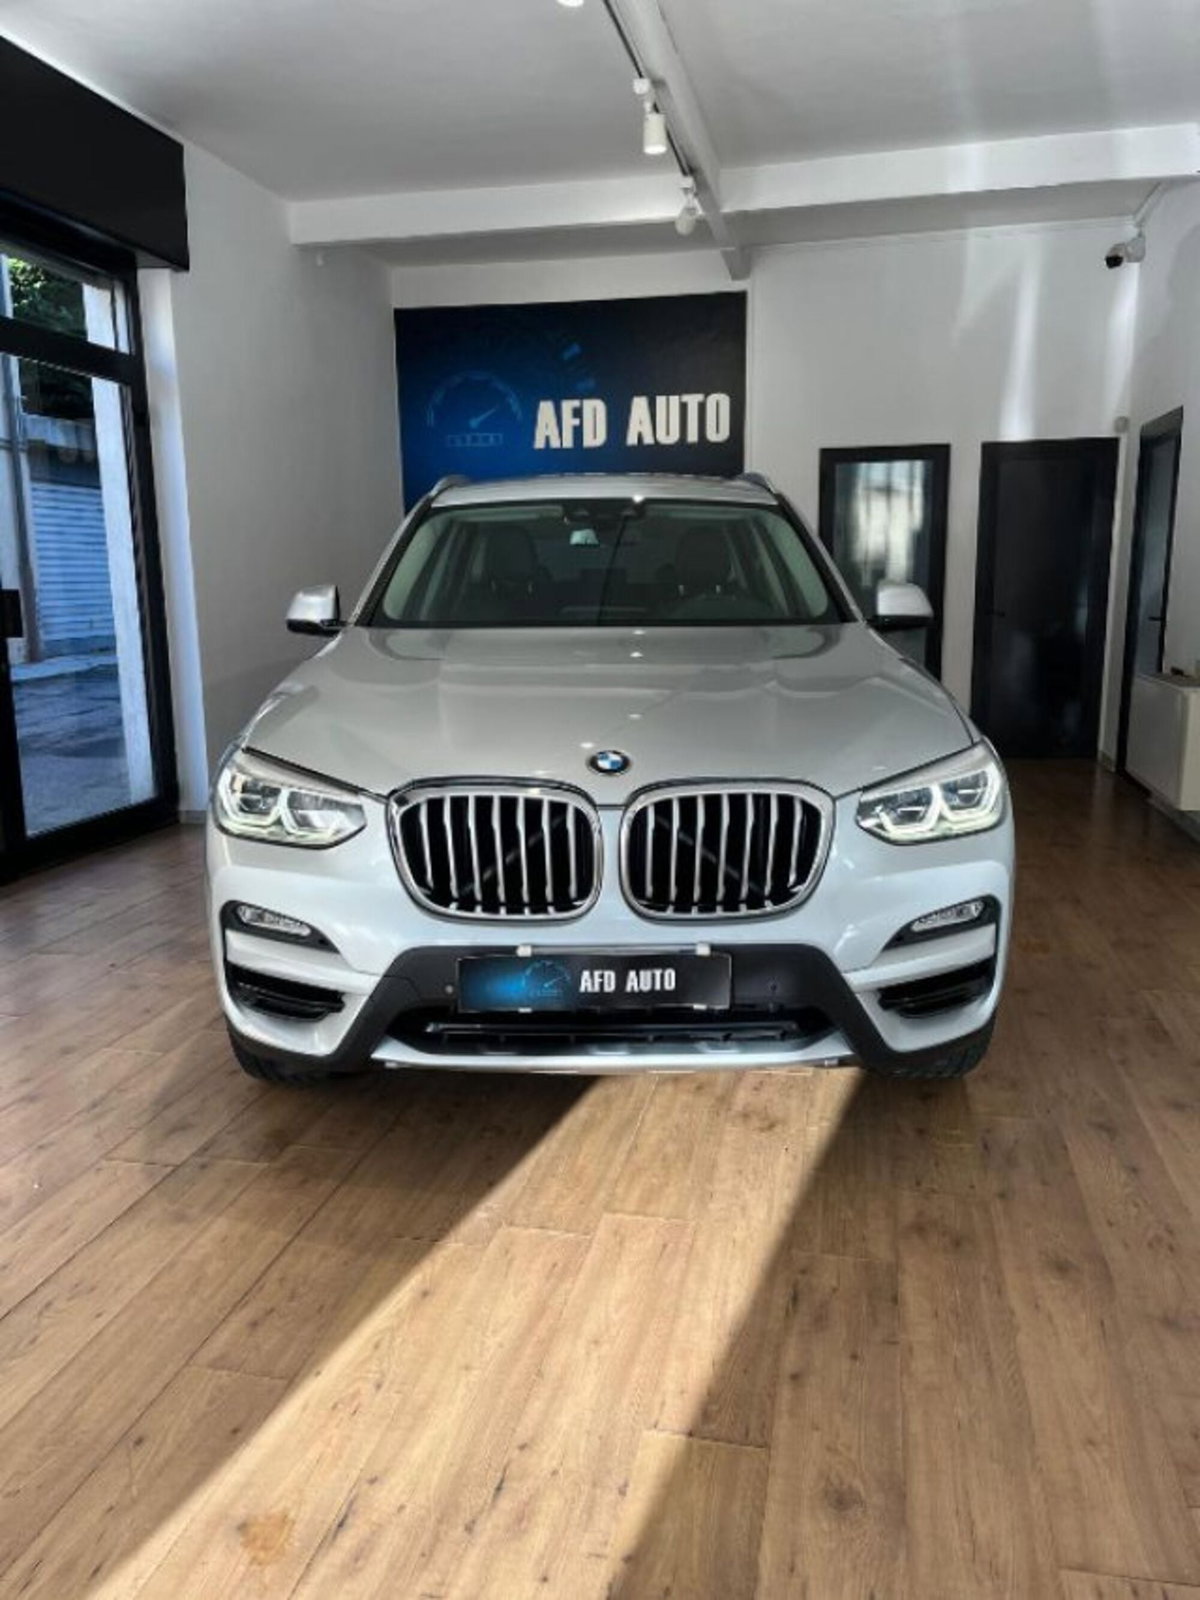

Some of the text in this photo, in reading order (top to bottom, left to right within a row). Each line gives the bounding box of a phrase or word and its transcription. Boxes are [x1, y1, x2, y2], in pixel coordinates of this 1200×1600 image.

[534, 393, 731, 449] AFD AUTO
[579, 968, 676, 993] AFD AUTO
